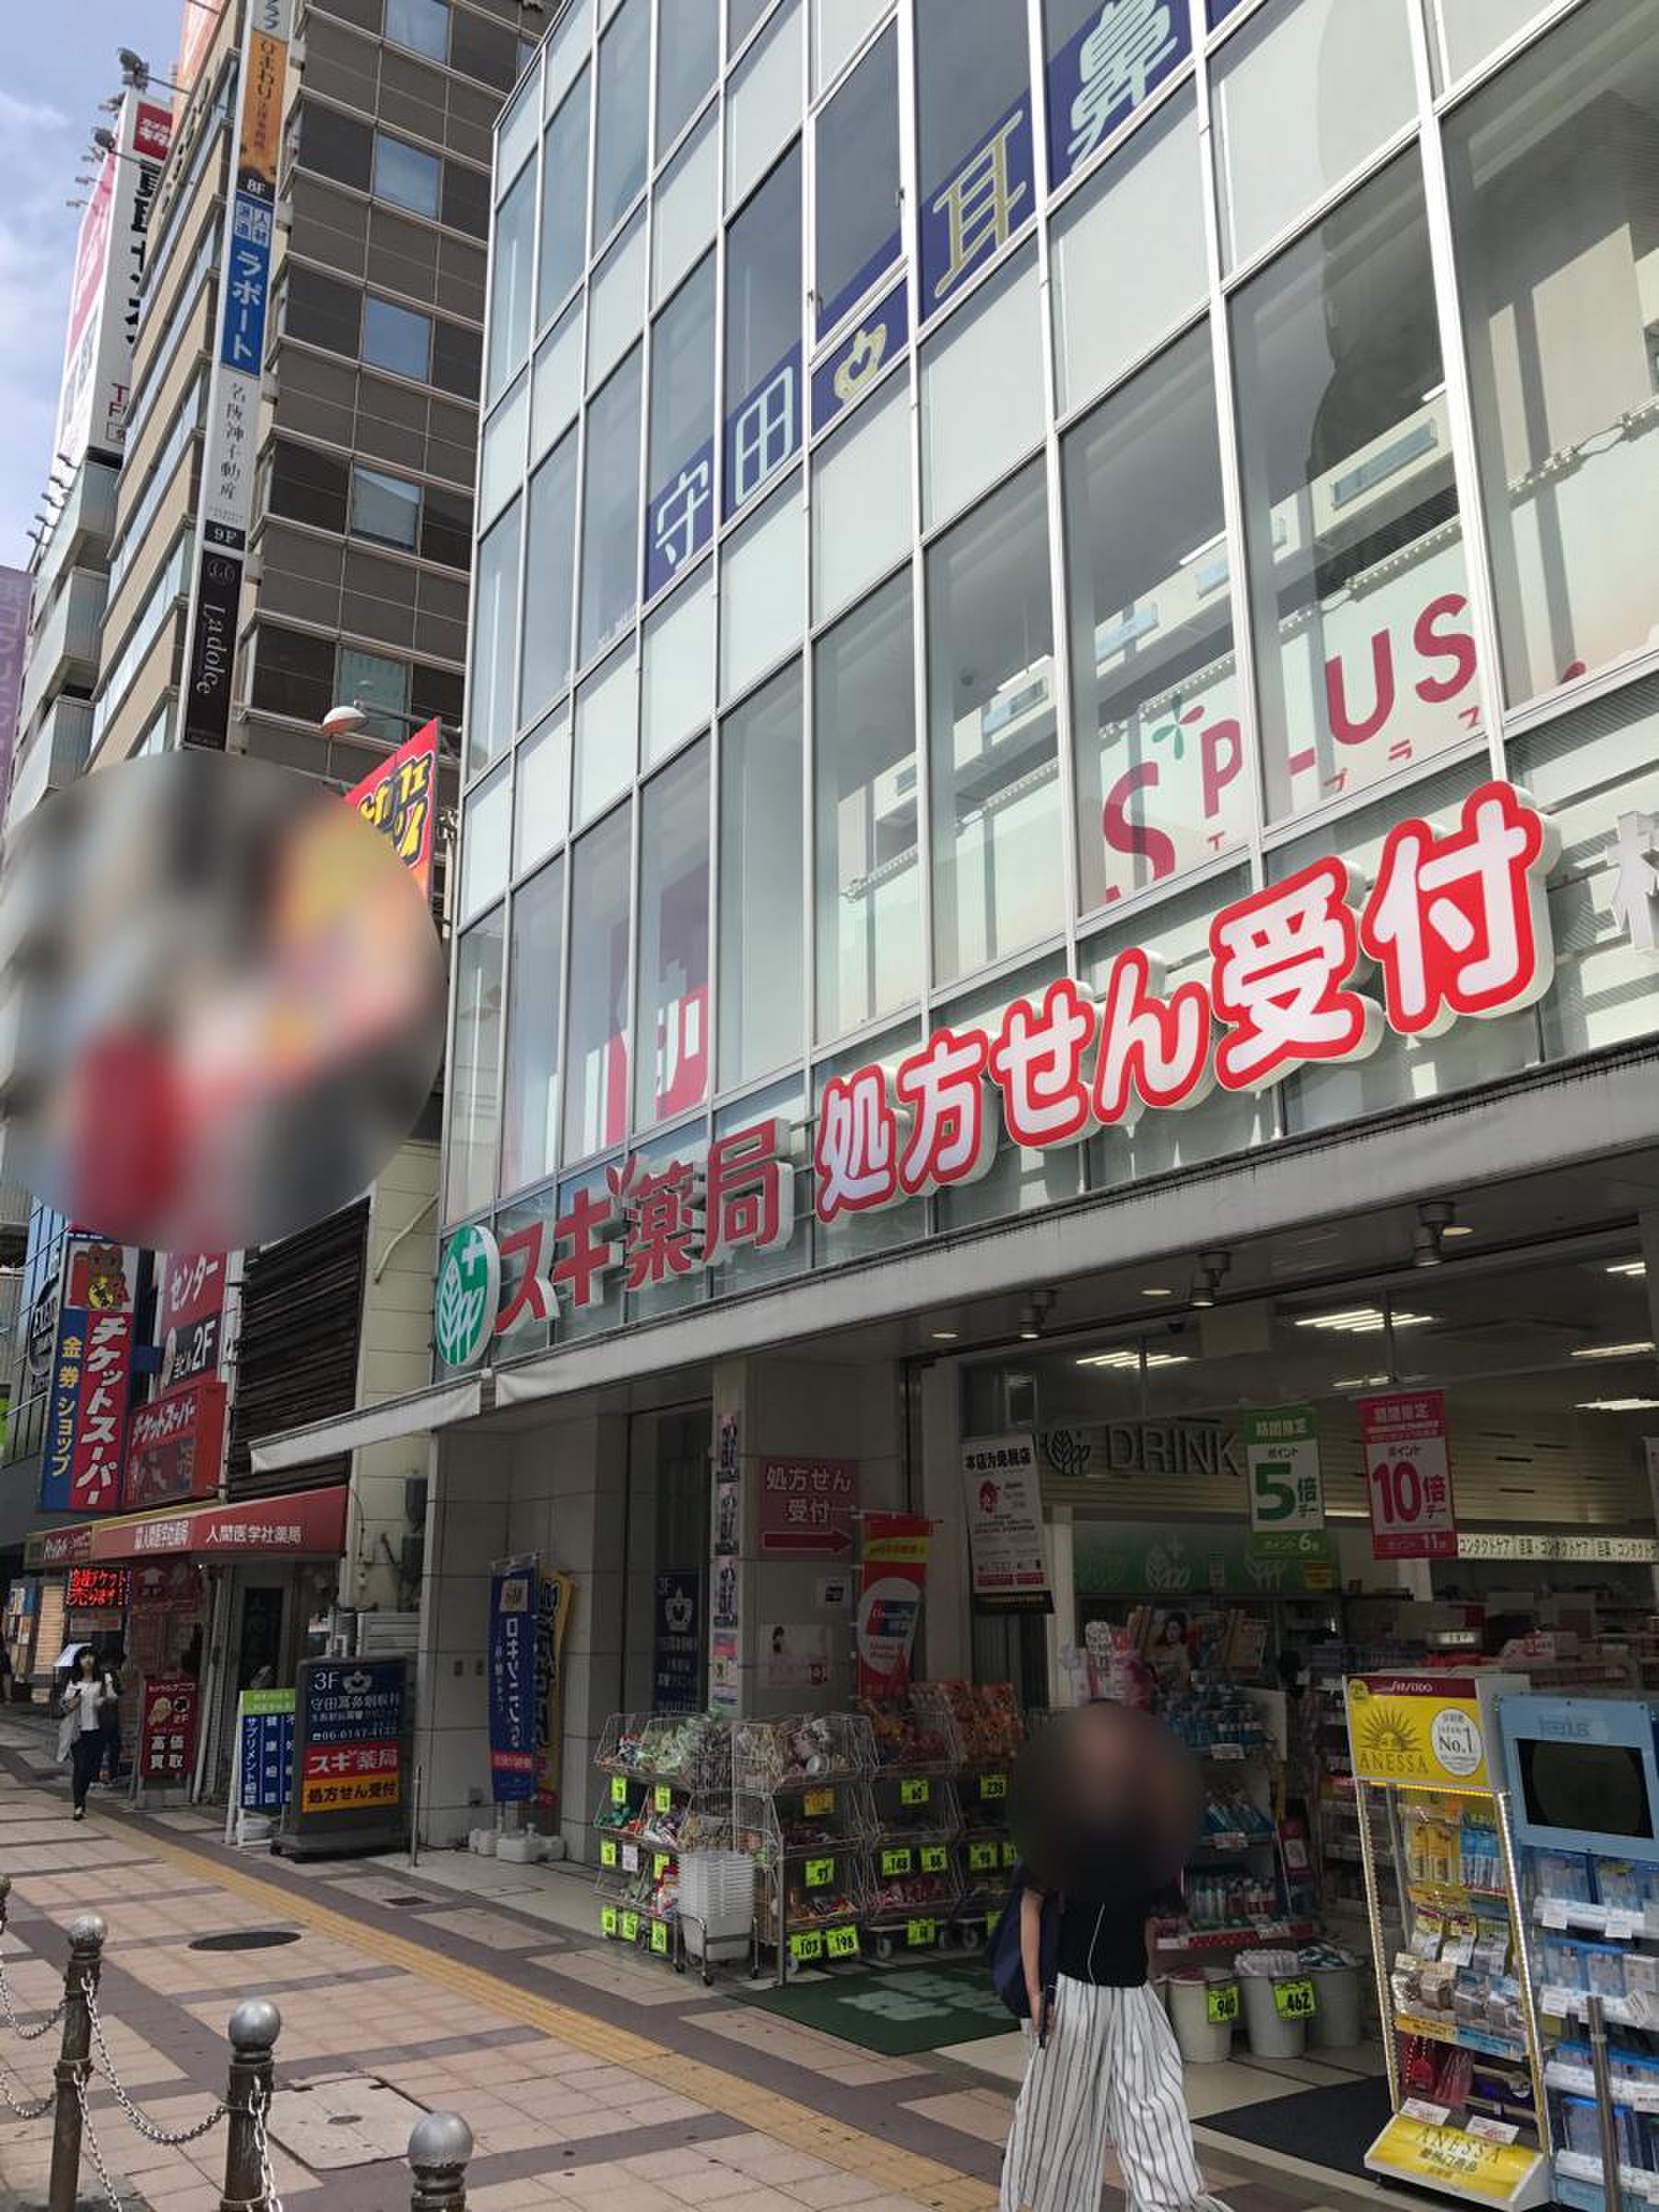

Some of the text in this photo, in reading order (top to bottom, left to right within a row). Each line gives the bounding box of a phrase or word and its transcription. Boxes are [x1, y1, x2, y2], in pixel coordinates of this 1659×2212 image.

[232, 251, 263, 359] ラポート
[214, 530, 237, 543] 9F
[815, 782, 1542, 1224] 処方せん受付
[495, 1120, 781, 1335] スギ薬局
[192, 1319, 217, 1373] 2F
[52, 1335, 83, 1477] 金券ショップ
[73, 1315, 128, 1505] チケットスーパー
[1106, 1425, 1241, 1477] DRINK
[766, 1466, 853, 1491] 処方せん
[786, 1498, 829, 1524] 受付
[313, 1671, 340, 1691] 3F
[309, 1748, 398, 1774] スギ薬局
[1359, 1753, 1429, 1774] ANESSA
[309, 1781, 396, 1804] 処方せん受付
